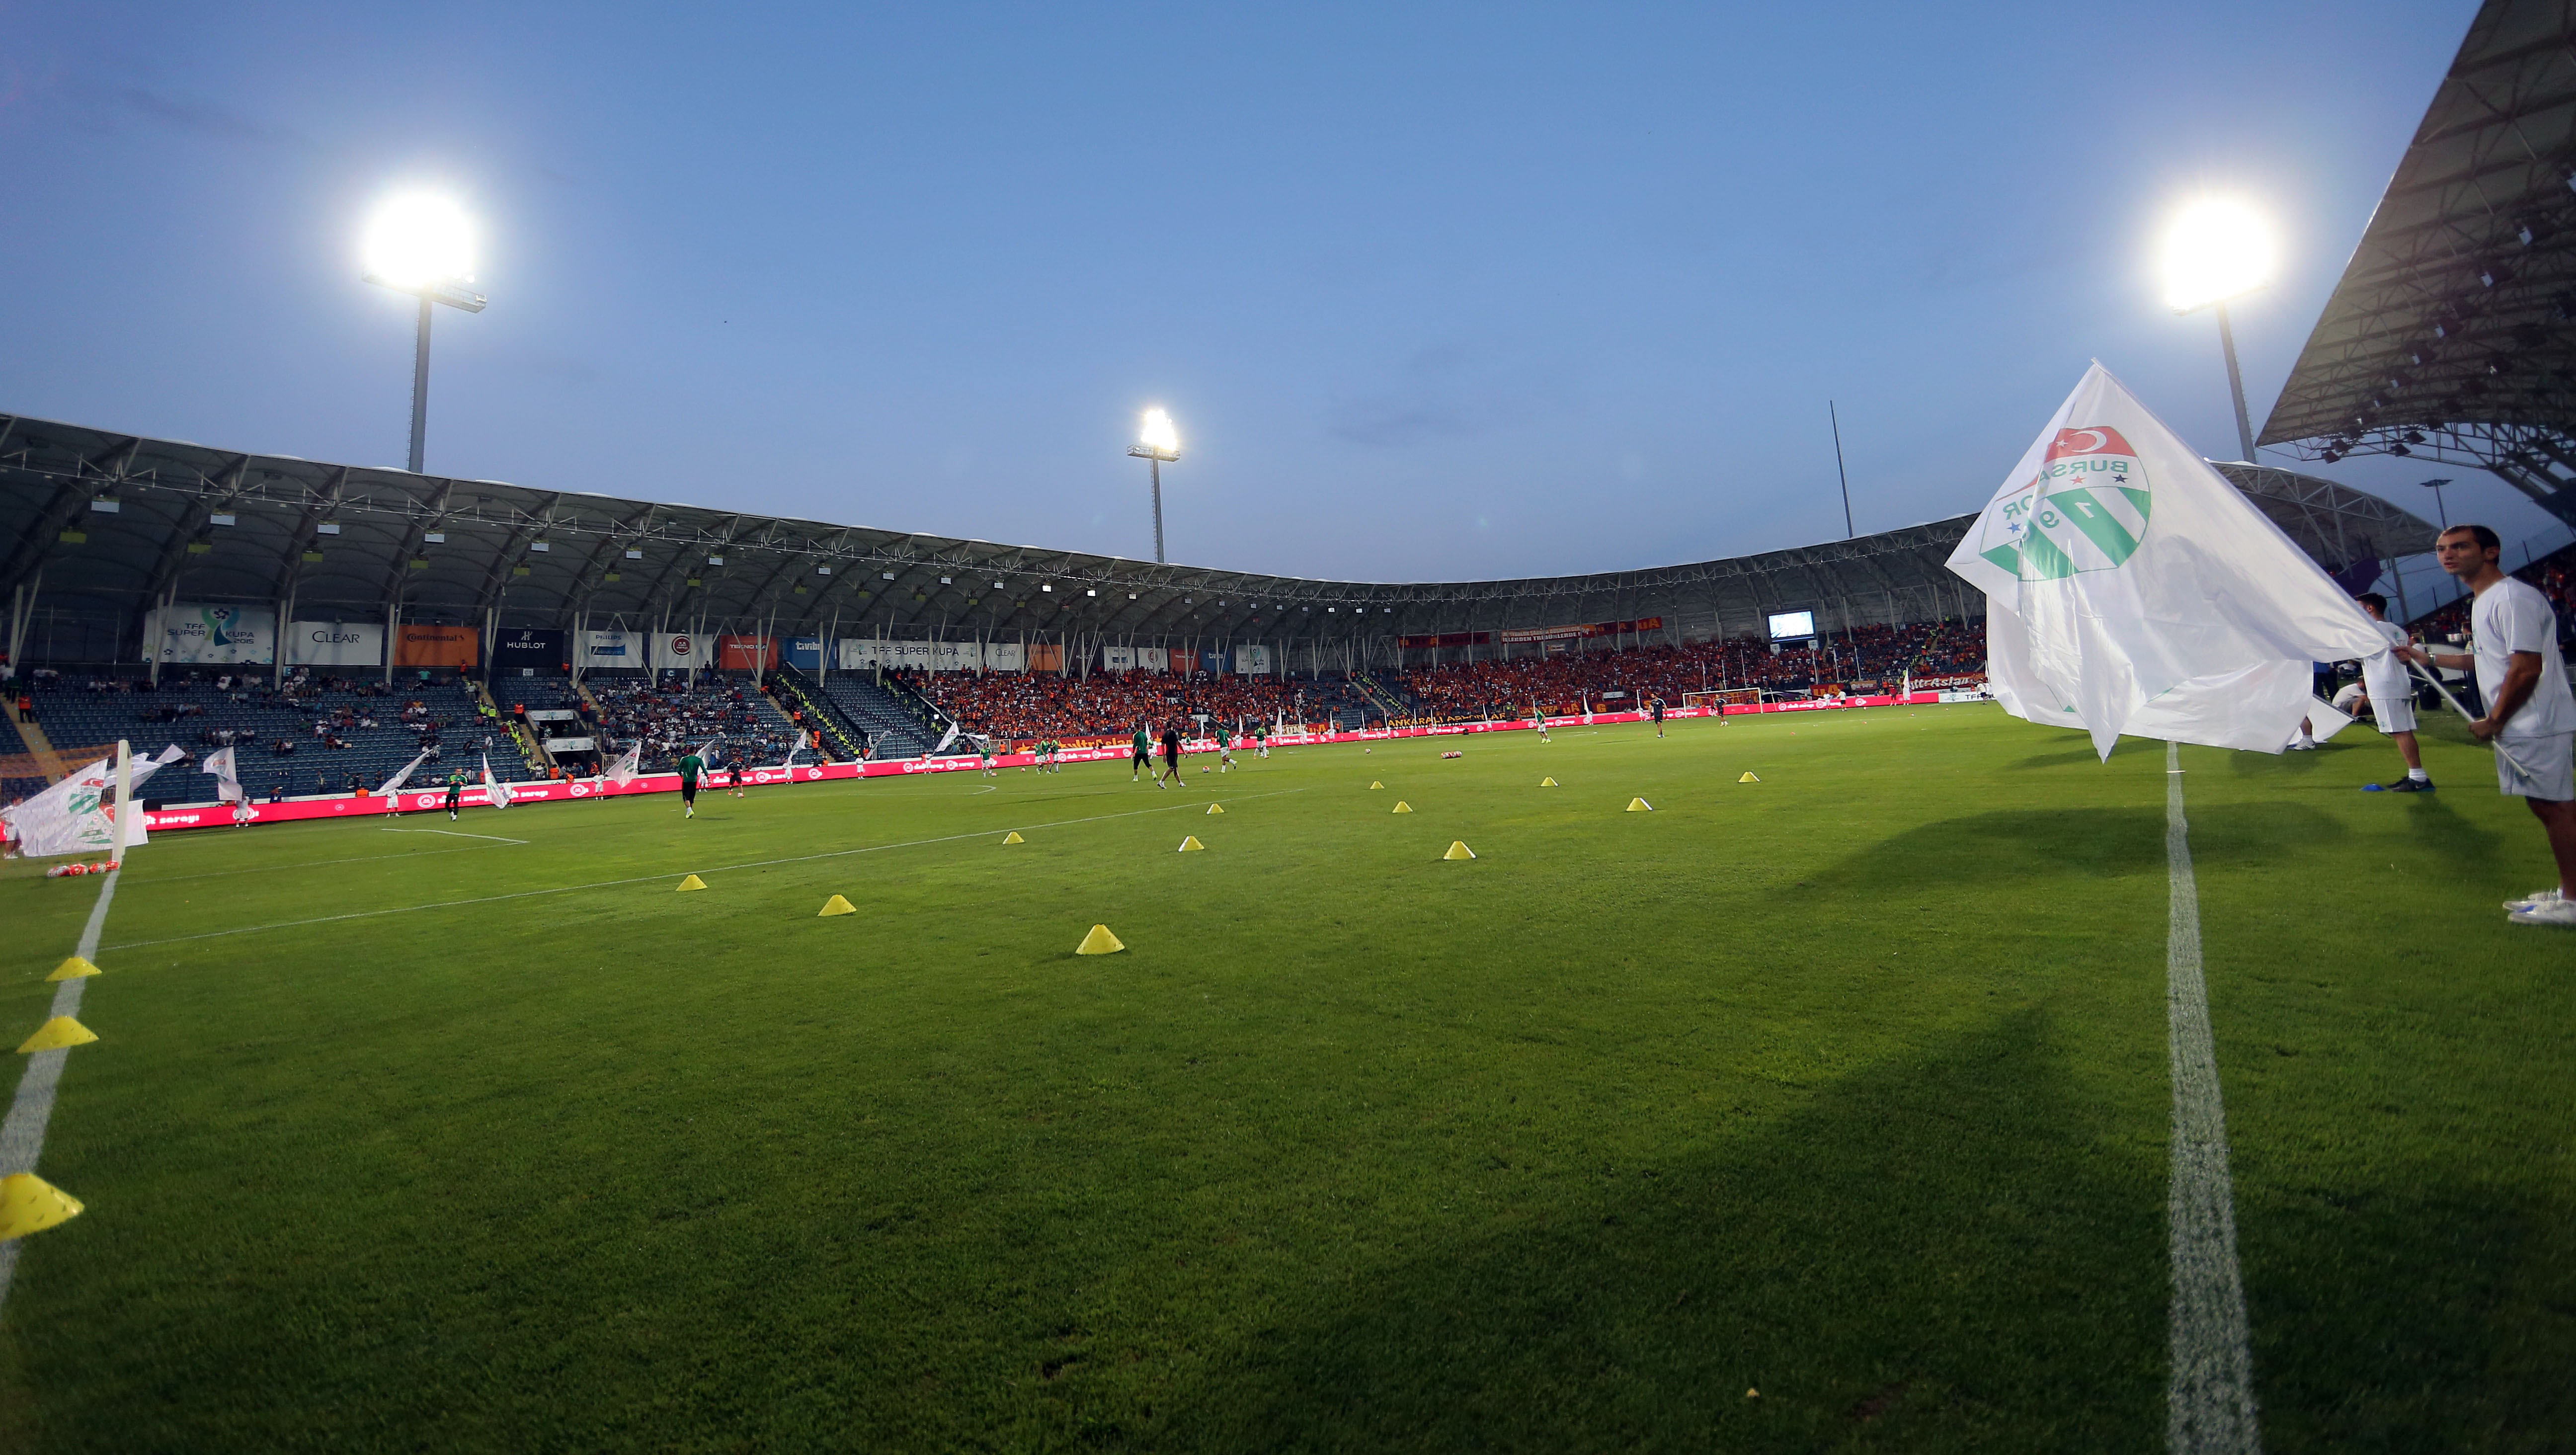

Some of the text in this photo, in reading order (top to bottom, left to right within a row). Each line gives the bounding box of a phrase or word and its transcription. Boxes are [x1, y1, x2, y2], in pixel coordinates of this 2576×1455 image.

[407, 633, 457, 642] Continental
[895, 645, 929, 655] SÜPER
[933, 647, 959, 656] KUPA
